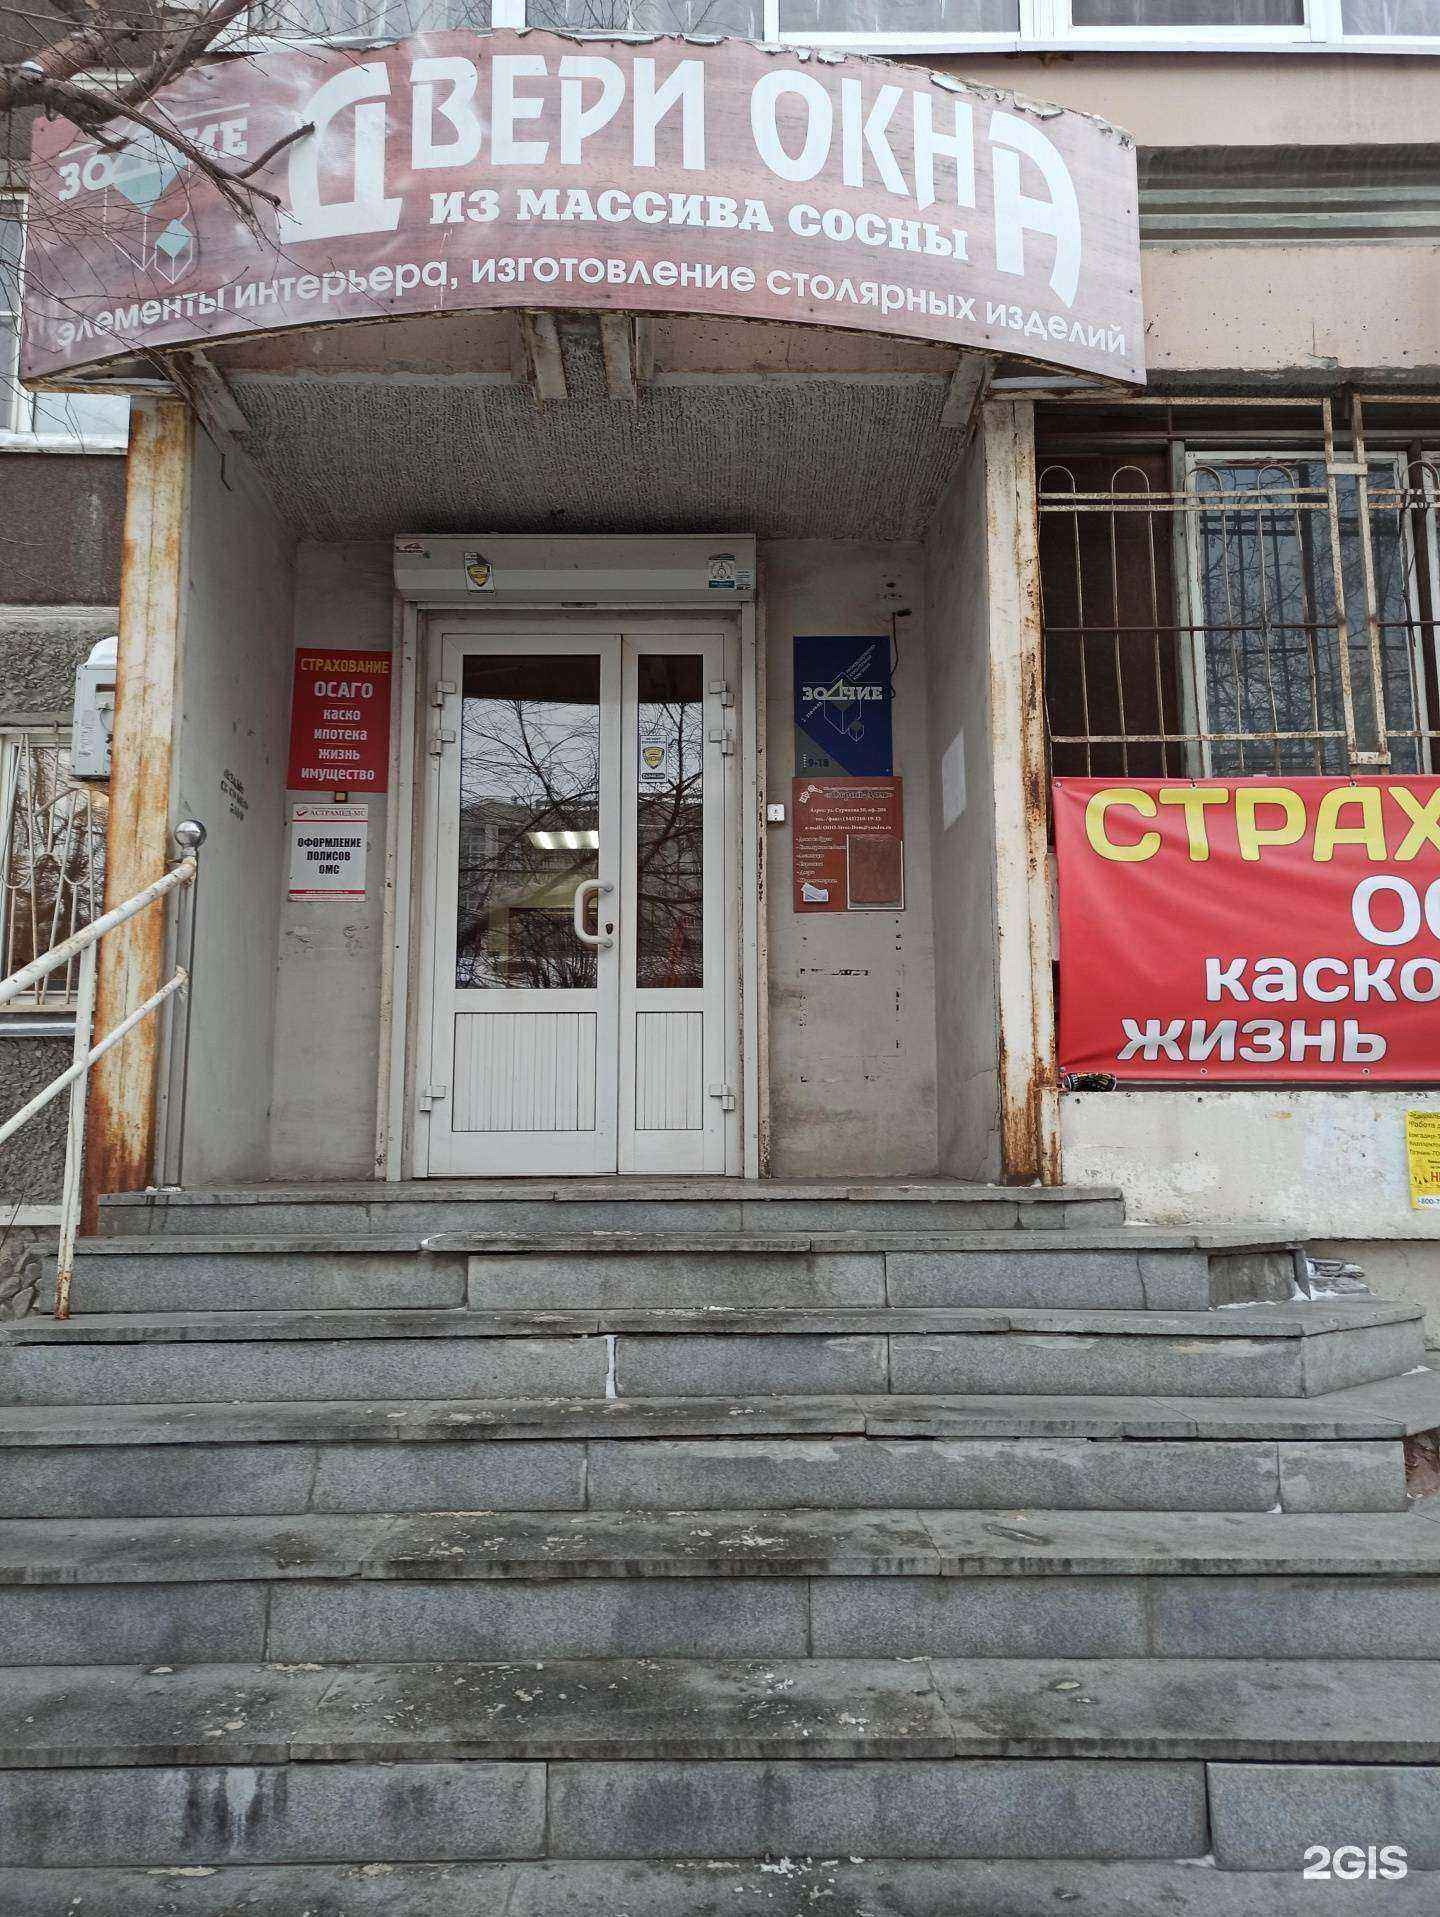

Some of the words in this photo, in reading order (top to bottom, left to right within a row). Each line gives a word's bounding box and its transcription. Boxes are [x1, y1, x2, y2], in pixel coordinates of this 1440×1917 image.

[281, 55, 705, 244] ДВЕРИ
[750, 69, 1082, 308] ОКНА
[516, 187, 773, 233] МАССИВА
[56, 286, 224, 348] элементы
[235, 259, 458, 308] интерьера,
[472, 256, 755, 292] изготовление
[767, 270, 976, 323] столярных
[985, 304, 1126, 356] изделий
[300, 658, 389, 674] СТРАХОВАНИЕ
[314, 681, 374, 699] ОСАГО
[323, 707, 361, 721] каско
[314, 728, 368, 741] ипотека
[318, 748, 360, 760] жизнь
[301, 769, 375, 781] имущество
[297, 837, 362, 848] ОФОРМЛЕНИЕ
[307, 851, 351, 861] ПОЛИСОВ
[318, 865, 340, 875] ОМС
[1352, 875, 1440, 945] О
[1205, 957, 1440, 1003] каско
[1117, 1019, 1387, 1063] жизнь
